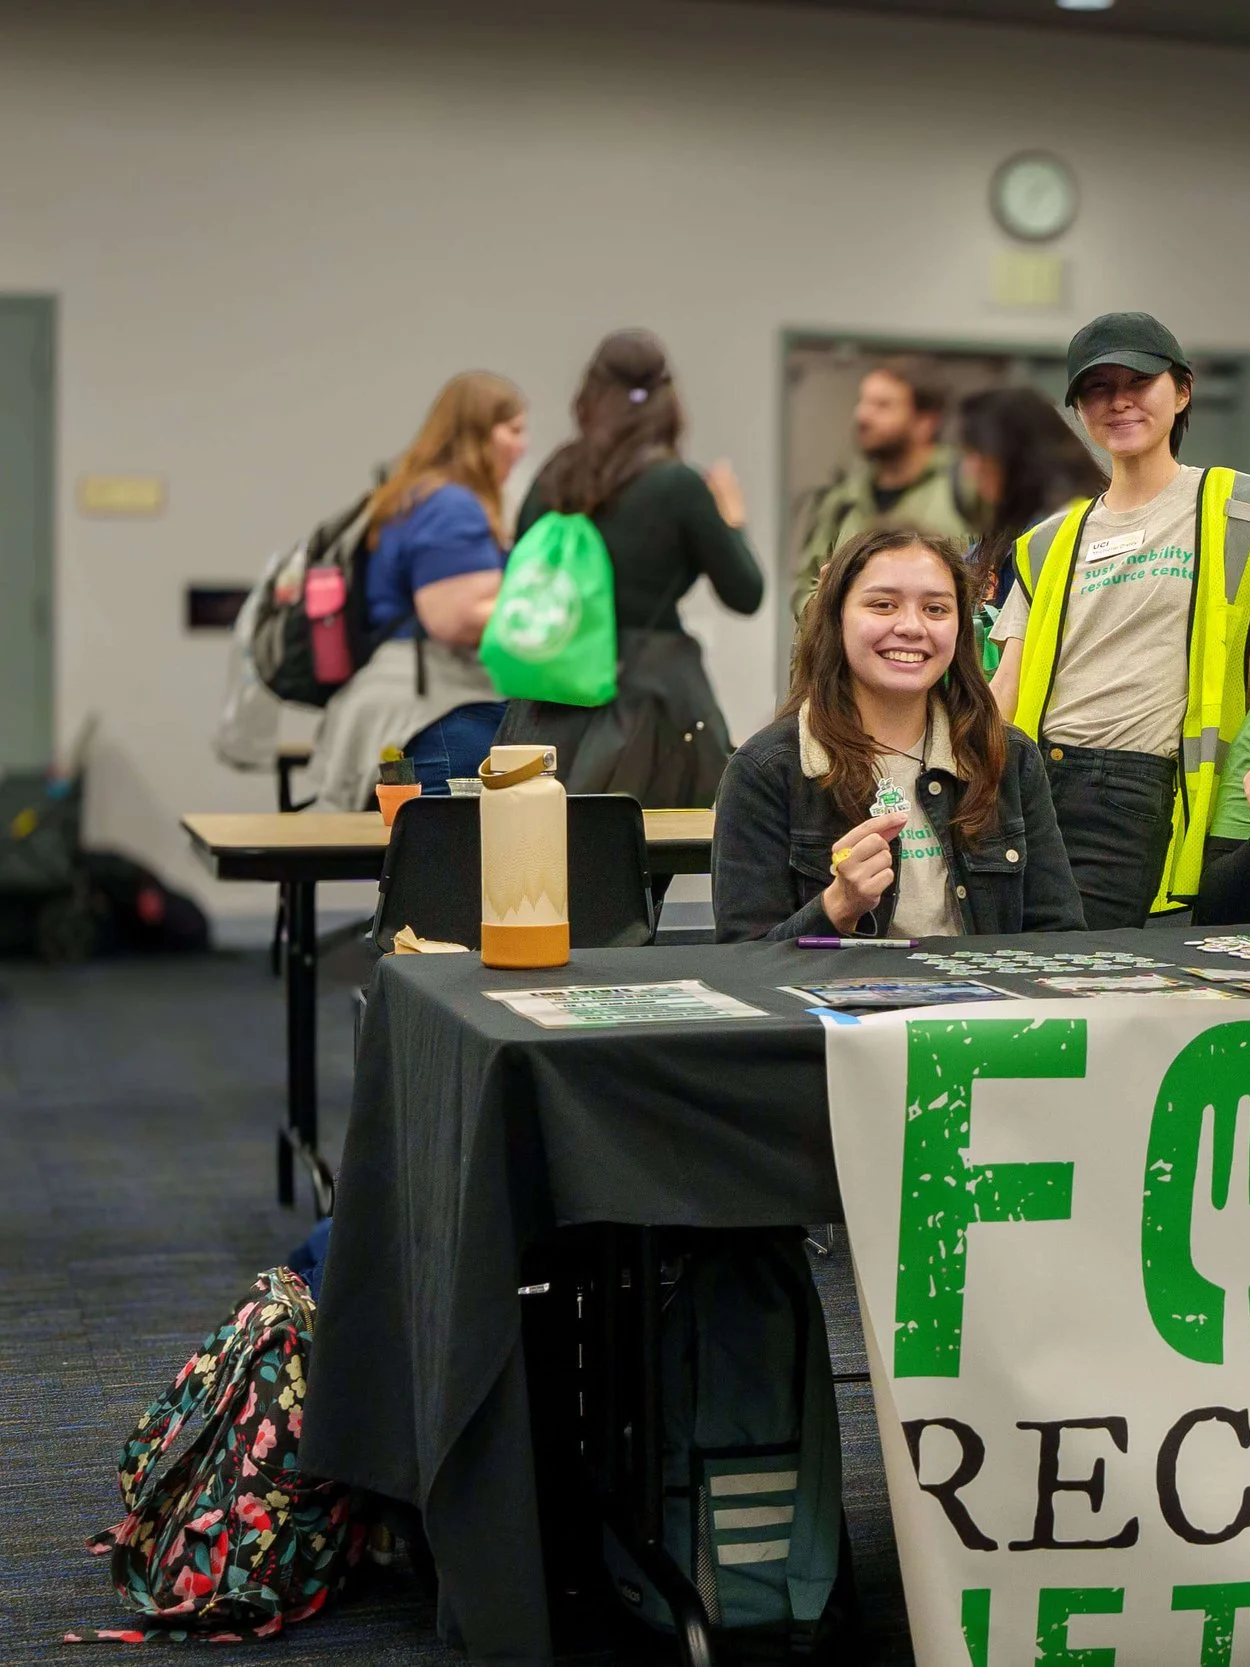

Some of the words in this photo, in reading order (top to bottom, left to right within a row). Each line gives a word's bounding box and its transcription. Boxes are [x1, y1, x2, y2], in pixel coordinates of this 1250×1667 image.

[1092, 540, 1110, 550] UCI
[1085, 545, 1194, 580] sustnability
[1080, 569, 1146, 596] resource
[1151, 566, 1194, 580] cente
[900, 846, 941, 860] esour
